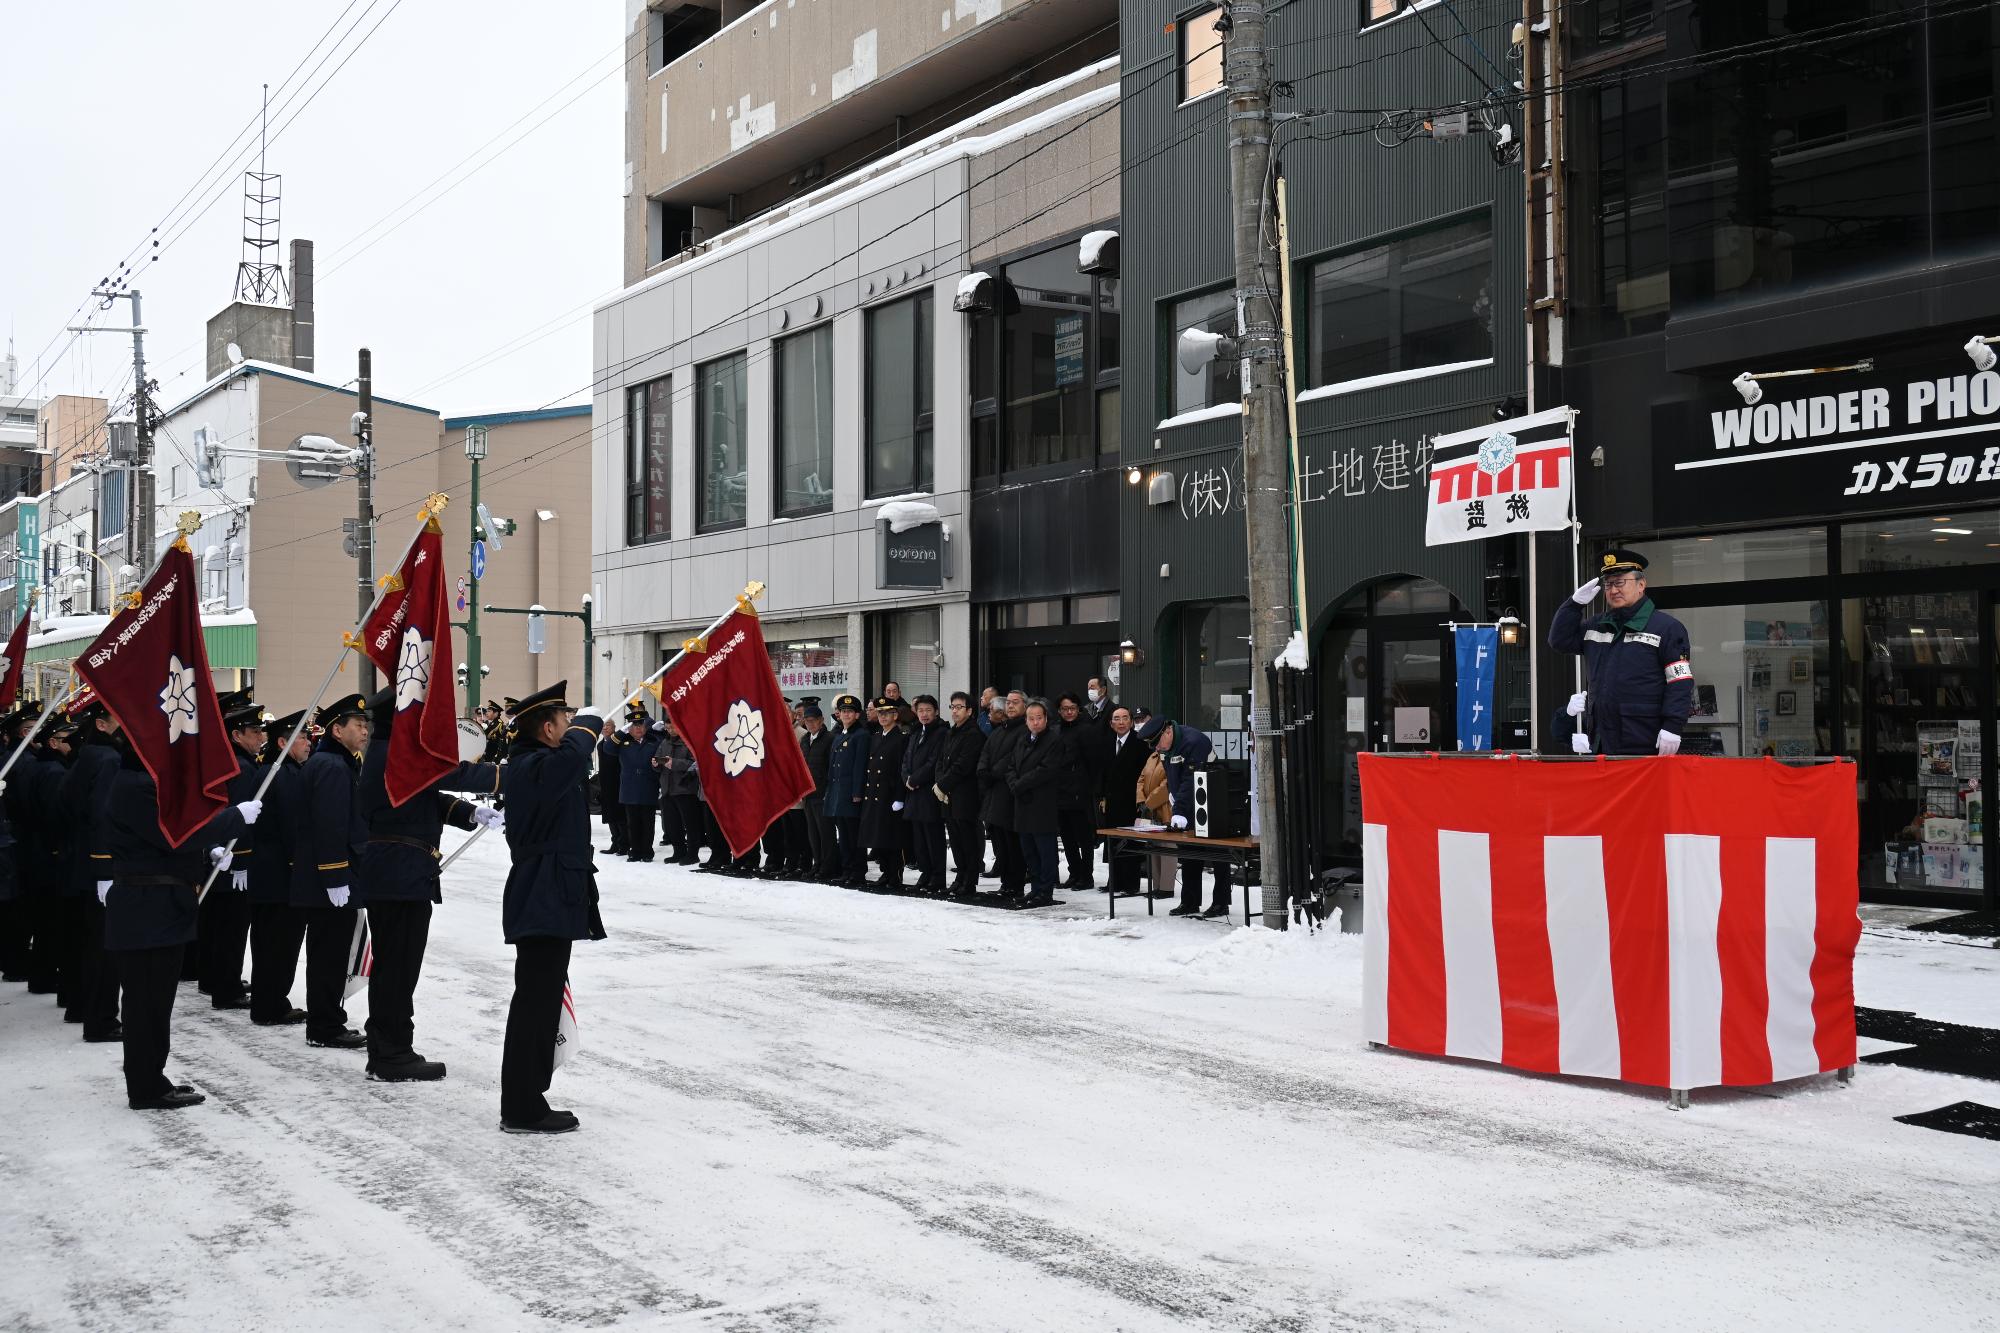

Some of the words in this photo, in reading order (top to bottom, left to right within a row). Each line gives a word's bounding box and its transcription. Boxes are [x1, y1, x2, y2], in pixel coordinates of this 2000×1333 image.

[1711, 387, 1890, 450] WONDER
[1908, 370, 2000, 424] PHO
[1180, 434, 1435, 520] (株)土地建
[21, 514, 38, 612] HIME
[888, 548, 937, 560] corona
[88, 573, 178, 669] 見沢消防団第八分団
[462, 726, 480, 738] YAMAHA
